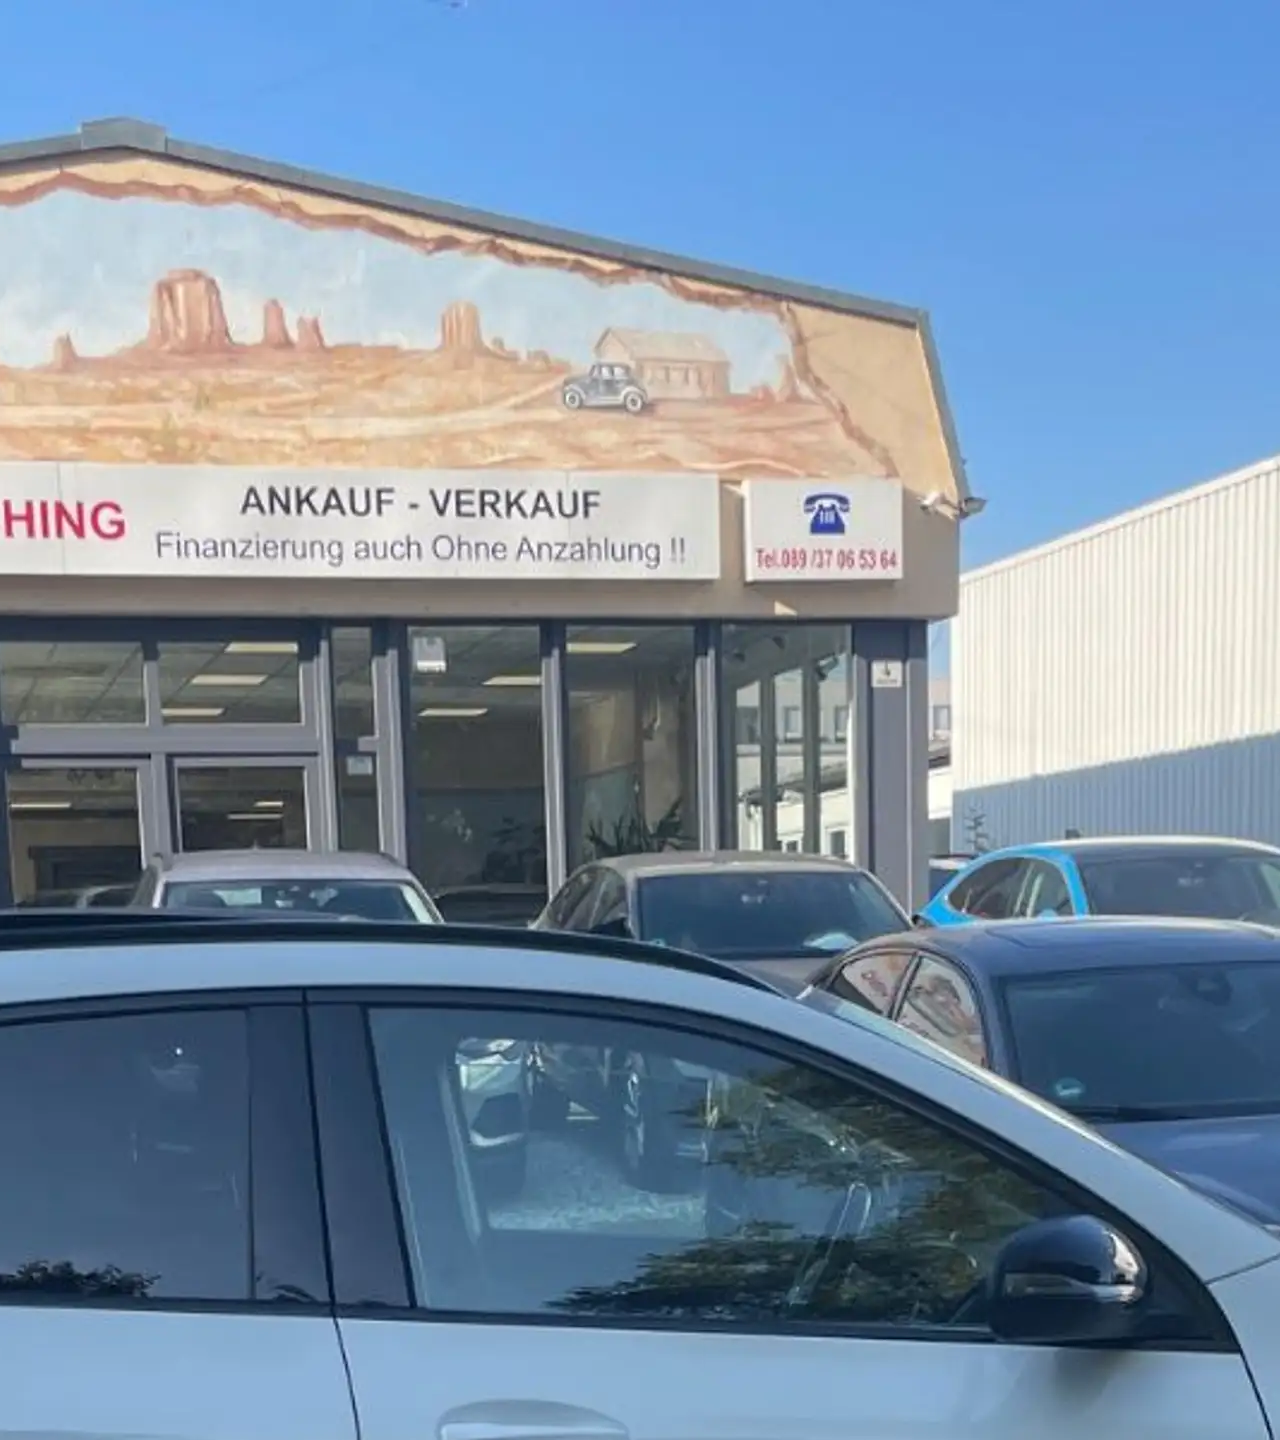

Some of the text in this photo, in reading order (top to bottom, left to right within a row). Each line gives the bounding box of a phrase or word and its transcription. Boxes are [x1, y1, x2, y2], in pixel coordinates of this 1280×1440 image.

[240, 487, 395, 517] ANKAUF
[429, 489, 601, 519] VERKAUF
[156, 532, 686, 569] Finanzierung auch Ohne Anzahlung !!
[837, 549, 855, 570] 06
[859, 549, 877, 570] 53
[880, 549, 897, 570] 64
